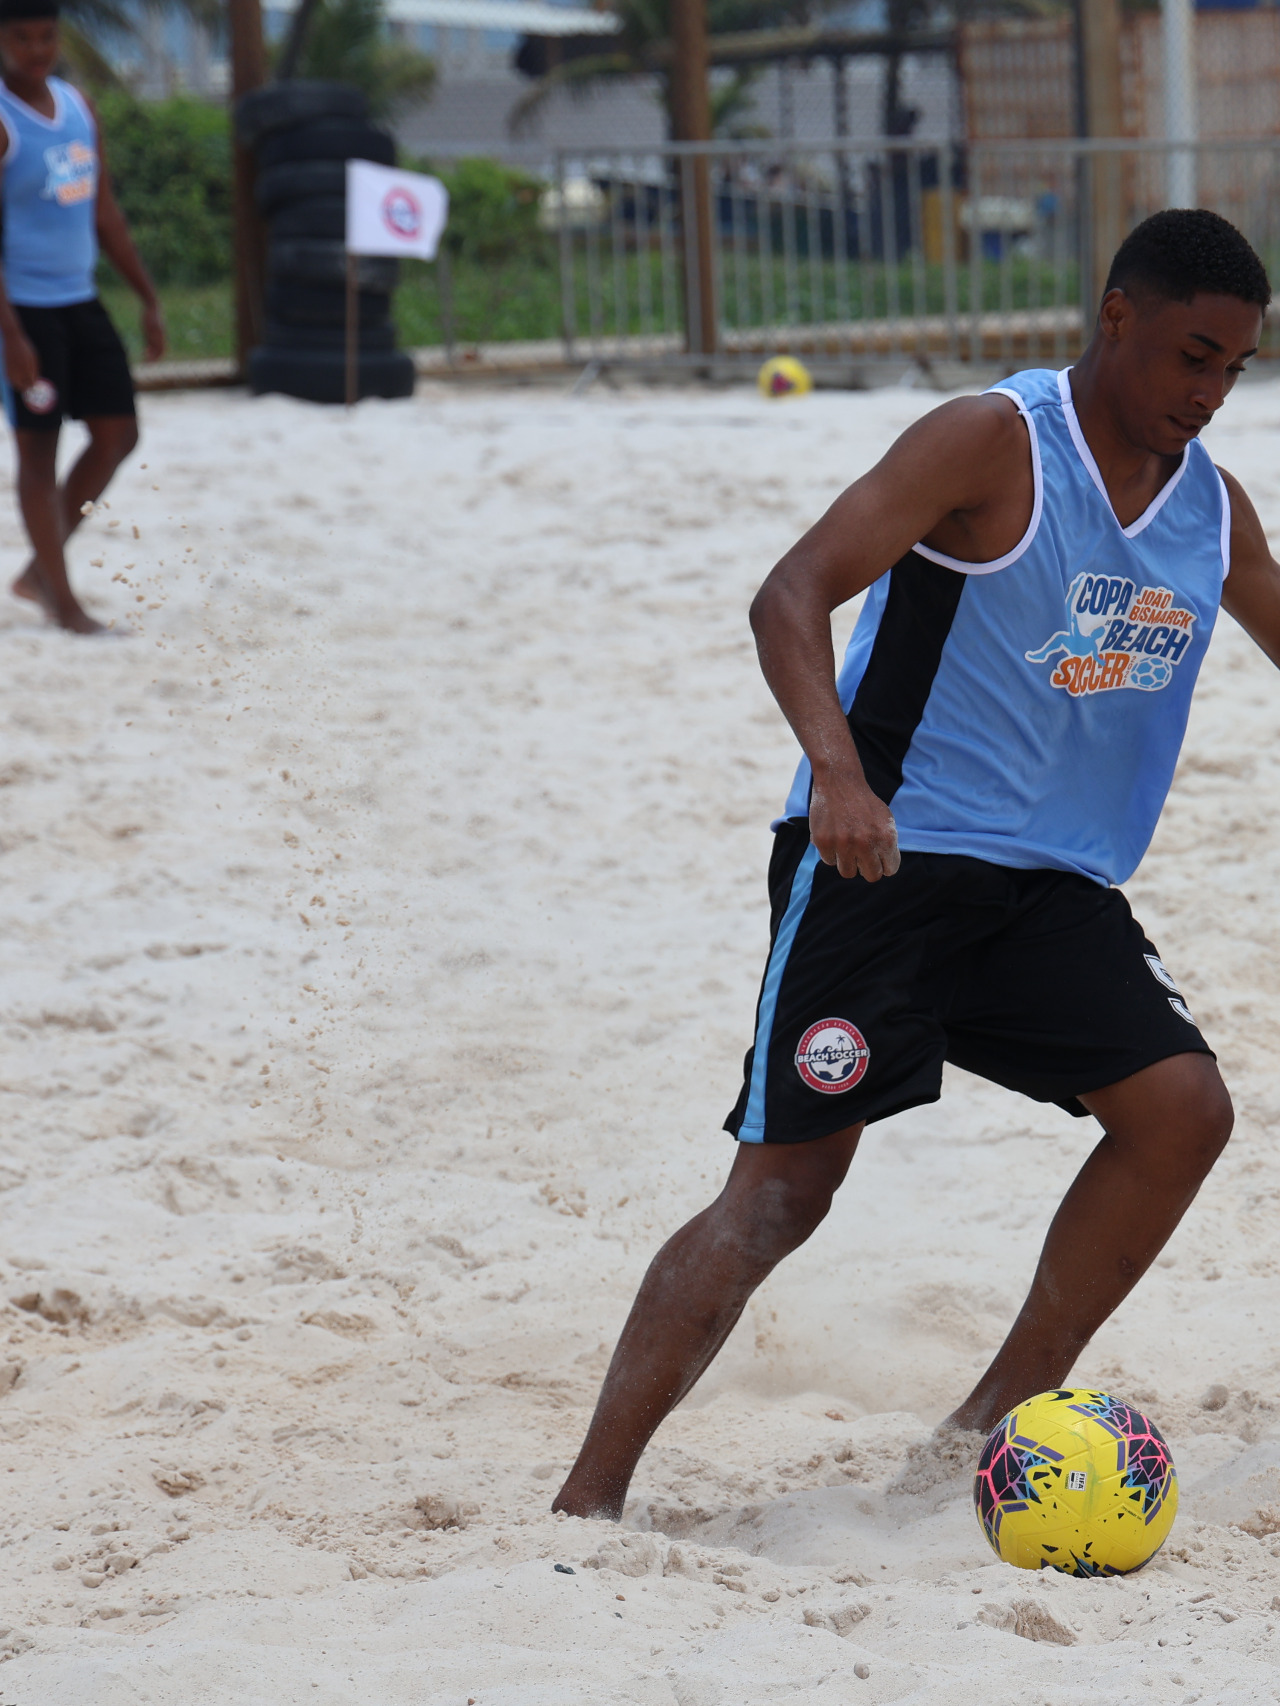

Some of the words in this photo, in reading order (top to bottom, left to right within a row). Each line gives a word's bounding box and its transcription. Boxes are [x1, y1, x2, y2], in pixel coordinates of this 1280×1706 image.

[1076, 576, 1133, 615] COPA
[1136, 588, 1171, 609] JOÃO
[1128, 604, 1193, 629] BISMARCK
[1100, 618, 1190, 661] BEACH
[1052, 652, 1130, 694] SOCCER
[797, 1053, 829, 1063] BEACH
[830, 1049, 867, 1060] SOCCER
[1078, 1473, 1086, 1489] FIFA
